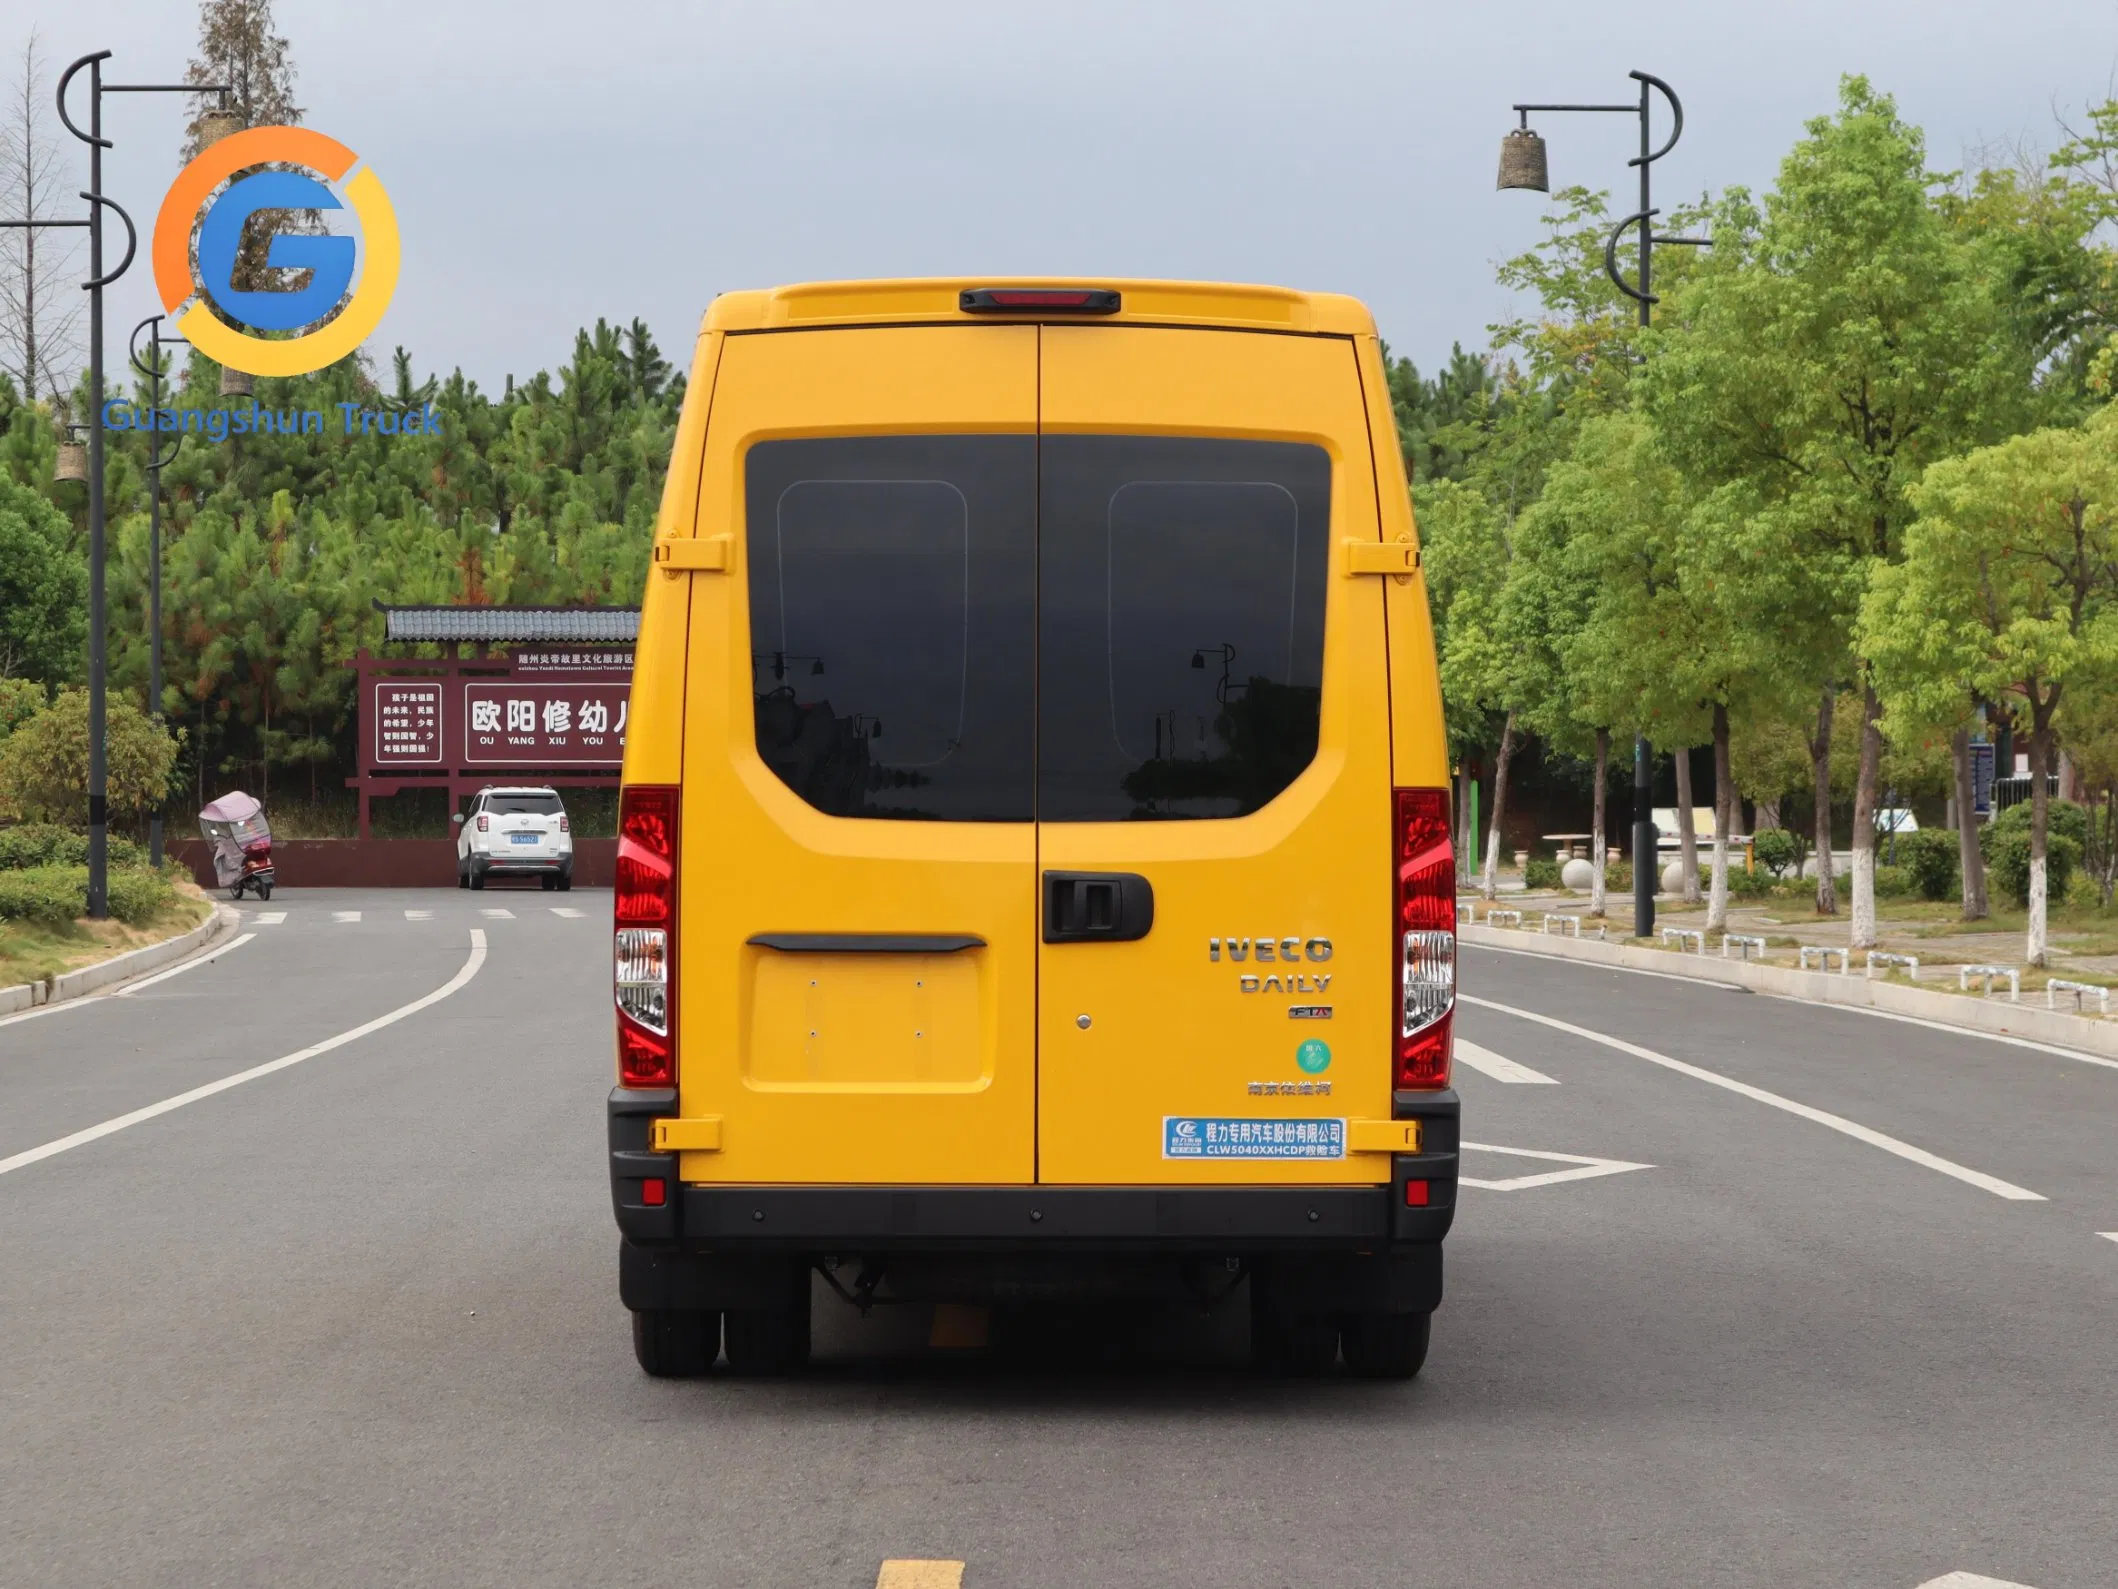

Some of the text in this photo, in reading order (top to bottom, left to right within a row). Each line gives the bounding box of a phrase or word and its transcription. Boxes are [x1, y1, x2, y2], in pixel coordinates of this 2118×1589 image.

[518, 653, 634, 664] 随州炎帝故里文化旅游区
[480, 736, 494, 745] OU
[508, 736, 535, 745] YANG
[549, 736, 566, 745] XIU
[583, 736, 604, 745] YOU
[1210, 936, 1333, 962] IVECO
[1240, 974, 1332, 993] DAILY
[1247, 1081, 1332, 1096] 南京依维柯
[1206, 1122, 1341, 1143] 程力专用汽车股份有限公司
